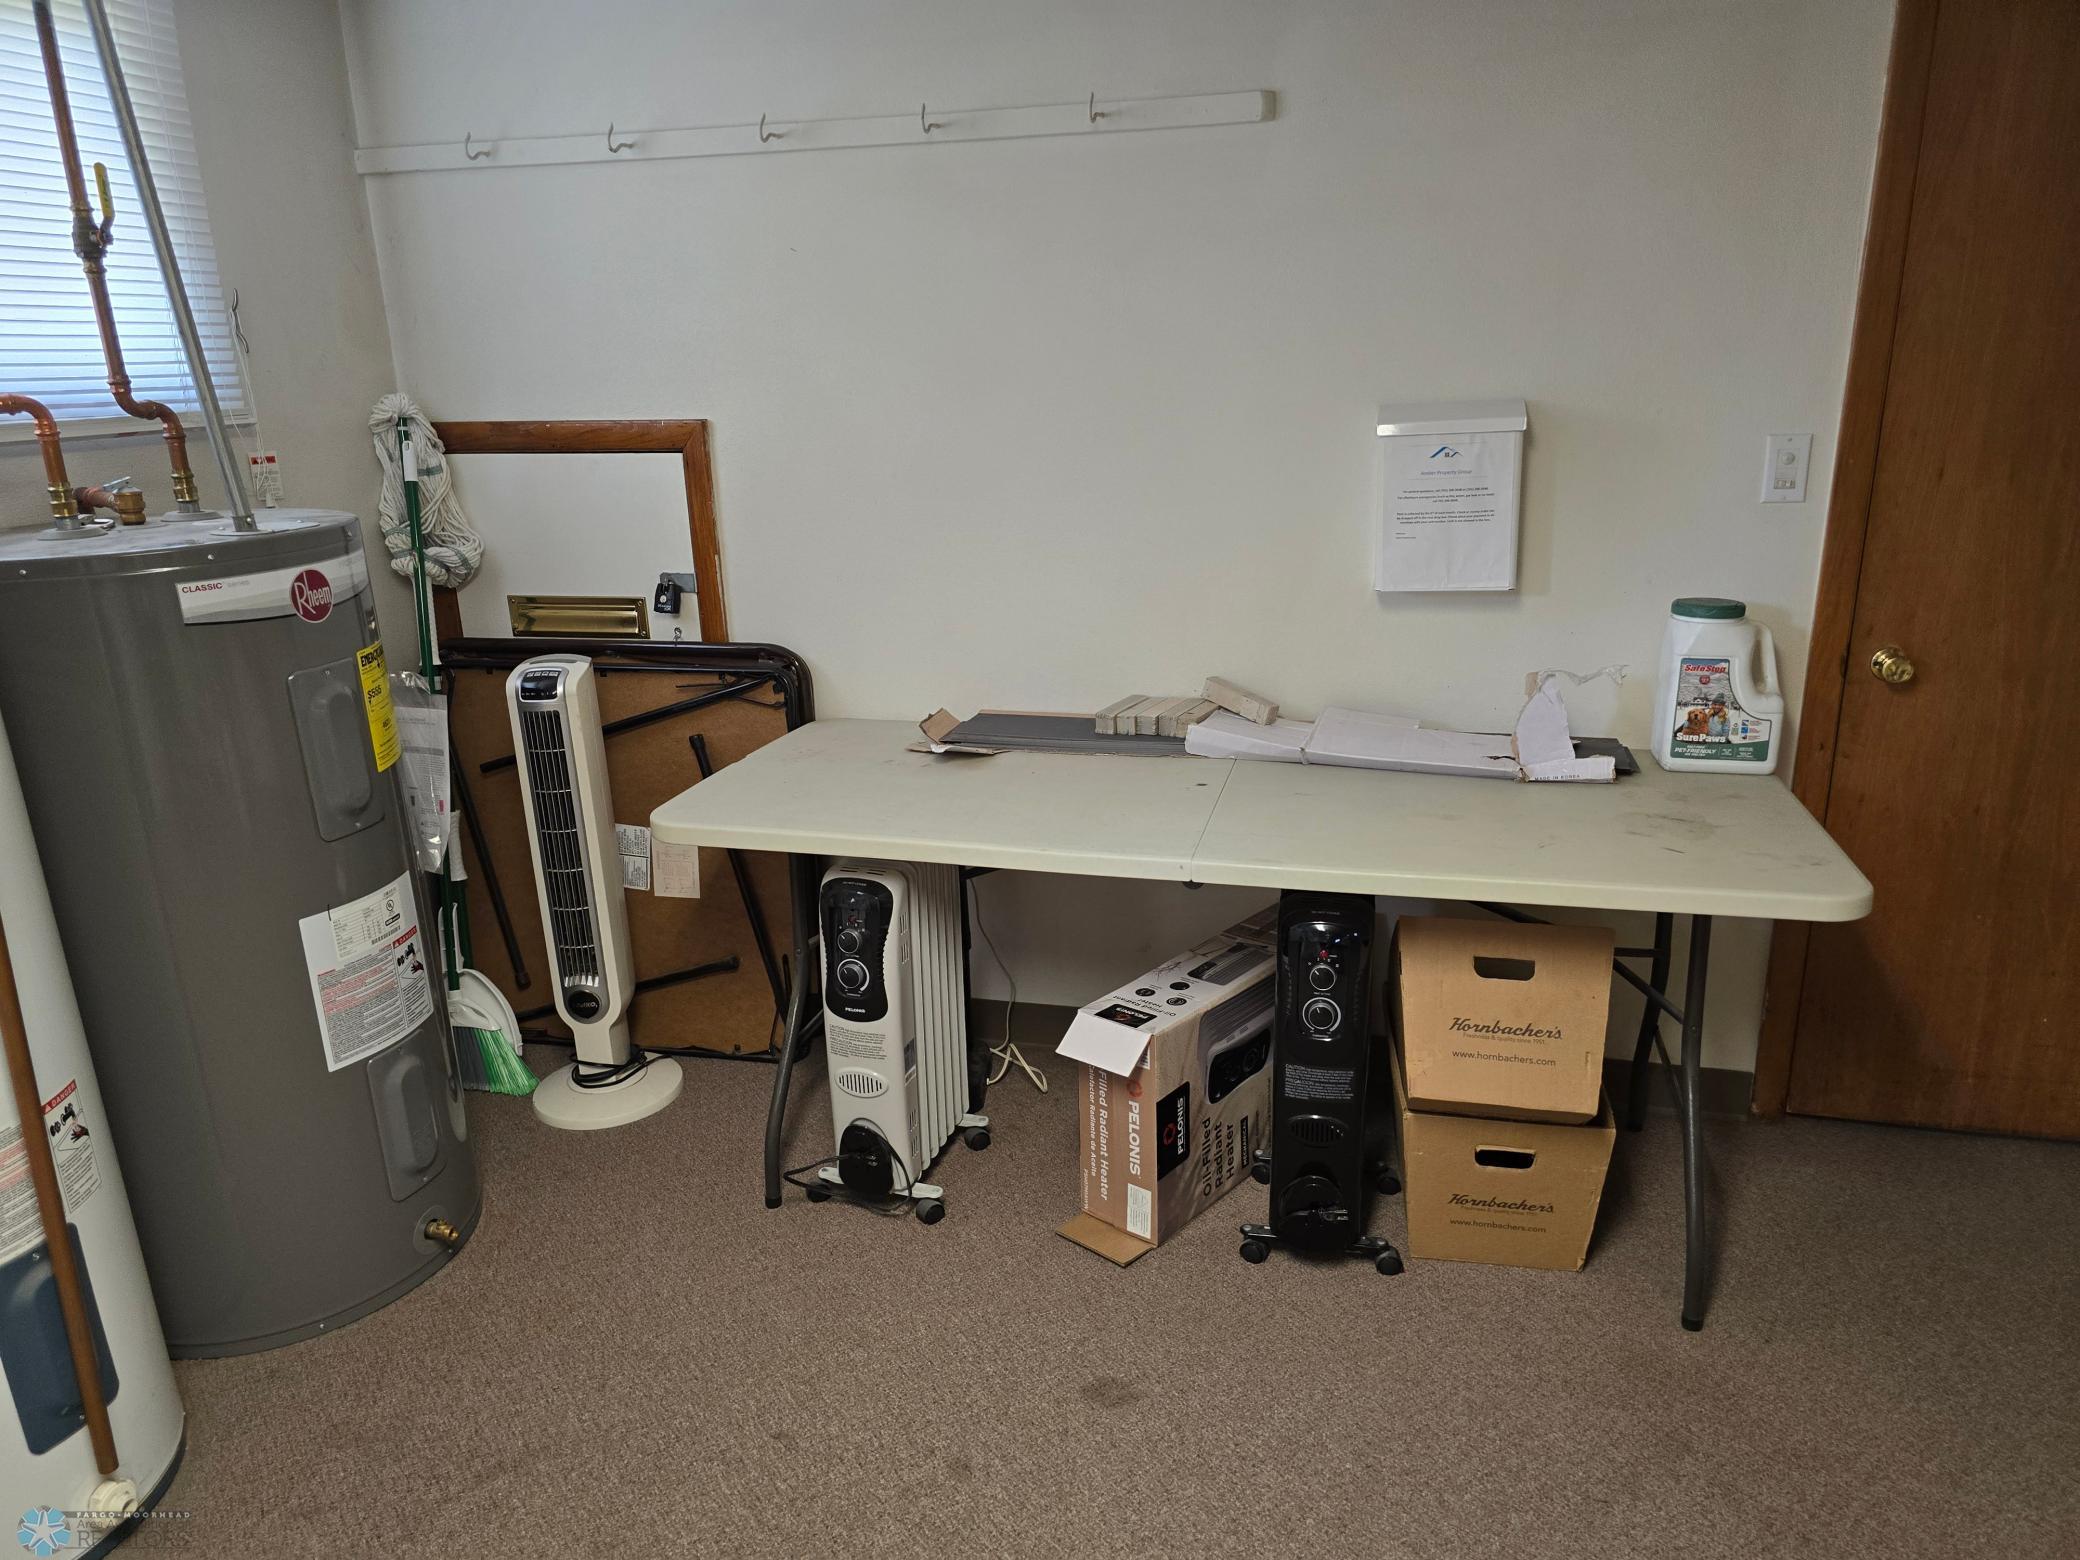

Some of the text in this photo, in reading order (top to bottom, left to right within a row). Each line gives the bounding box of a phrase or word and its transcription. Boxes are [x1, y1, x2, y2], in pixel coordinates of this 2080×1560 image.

[181, 581, 223, 594] CLASSIC
[293, 571, 332, 615] Rheem
[1448, 1017, 1562, 1040] Hornbacher's
[1451, 1050, 1557, 1067] www.hornbachers.com
[51, 1083, 76, 1108] DANGER
[1099, 1108, 1109, 1157] Radiant
[1128, 1100, 1141, 1179] PELONIS
[1177, 1097, 1185, 1155] PELONIS
[1202, 1116, 1212, 1197] Oil-Filled
[1213, 1120, 1224, 1189] Radiant
[1225, 1123, 1235, 1180] Heater
[1100, 1159, 1109, 1201] Heater
[1448, 1193, 1554, 1213] Hornbacher's
[1449, 1218, 1547, 1234] www.hornbachers.com
